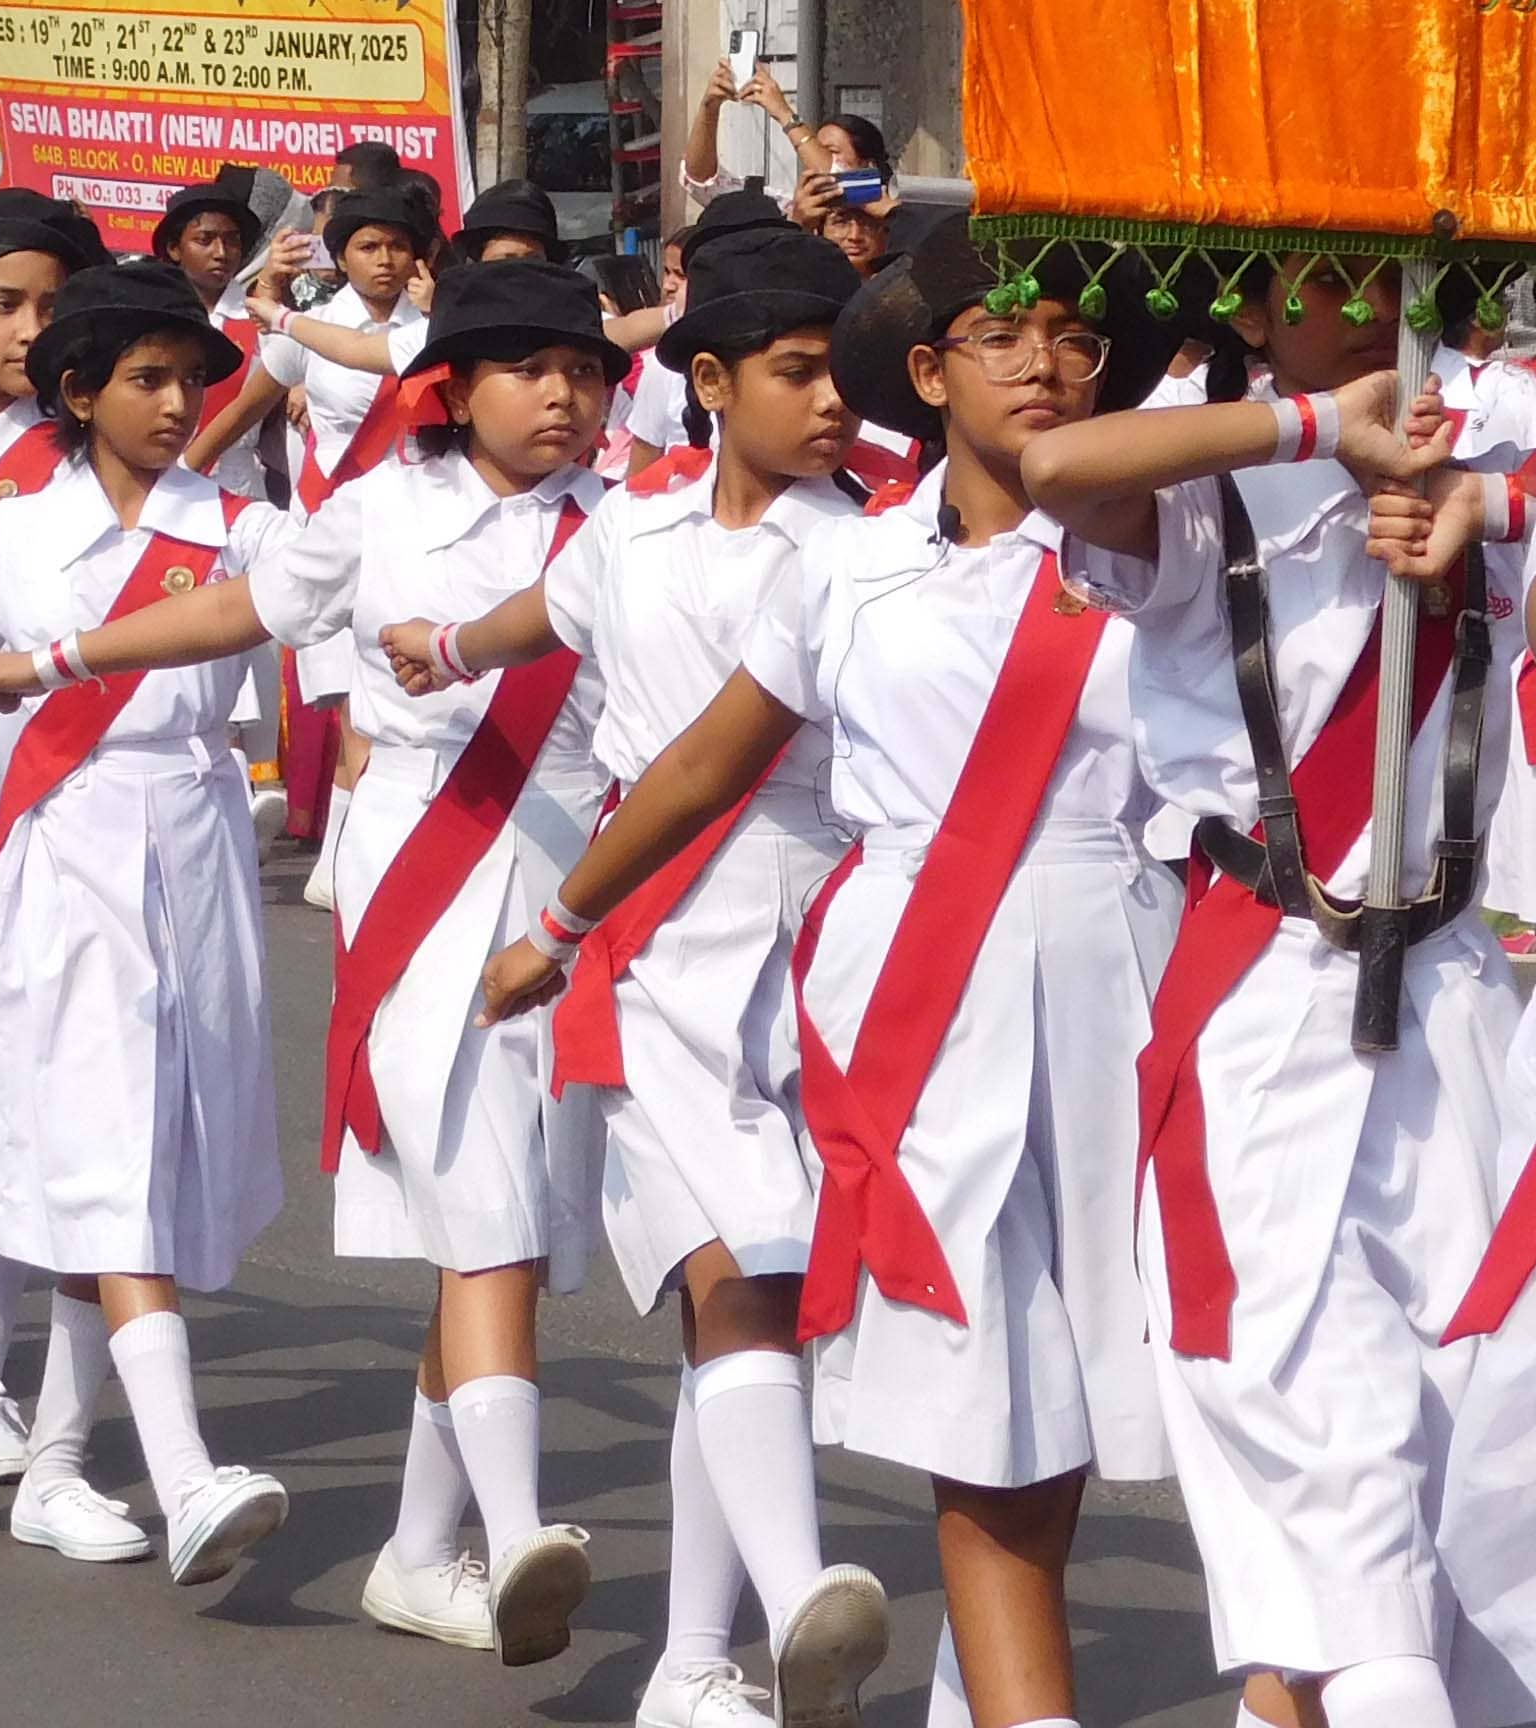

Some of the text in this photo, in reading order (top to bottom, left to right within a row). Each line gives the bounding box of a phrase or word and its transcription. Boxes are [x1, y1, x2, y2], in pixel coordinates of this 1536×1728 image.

[203, 32, 216, 53] &
[264, 30, 356, 65] JANUARY,
[360, 34, 408, 62] 2025
[53, 54, 96, 79] TIME
[112, 58, 150, 83] 9:00
[157, 60, 195, 85] A.M.
[202, 63, 225, 86] TO
[232, 65, 271, 89] 2:00
[277, 67, 312, 91] P.M.
[9, 103, 62, 139] SEVA
[67, 107, 153, 144] BHARTI
[160, 112, 223, 153] (NEW
[230, 118, 343, 156] ALIPORE)
[32, 143, 65, 167] 644B,
[68, 147, 118, 171] BLOCK
[132, 152, 149, 176] O,
[152, 154, 186, 177] NEW
[190, 157, 260, 179] ALIP
[115, 186, 142, 205] 033
